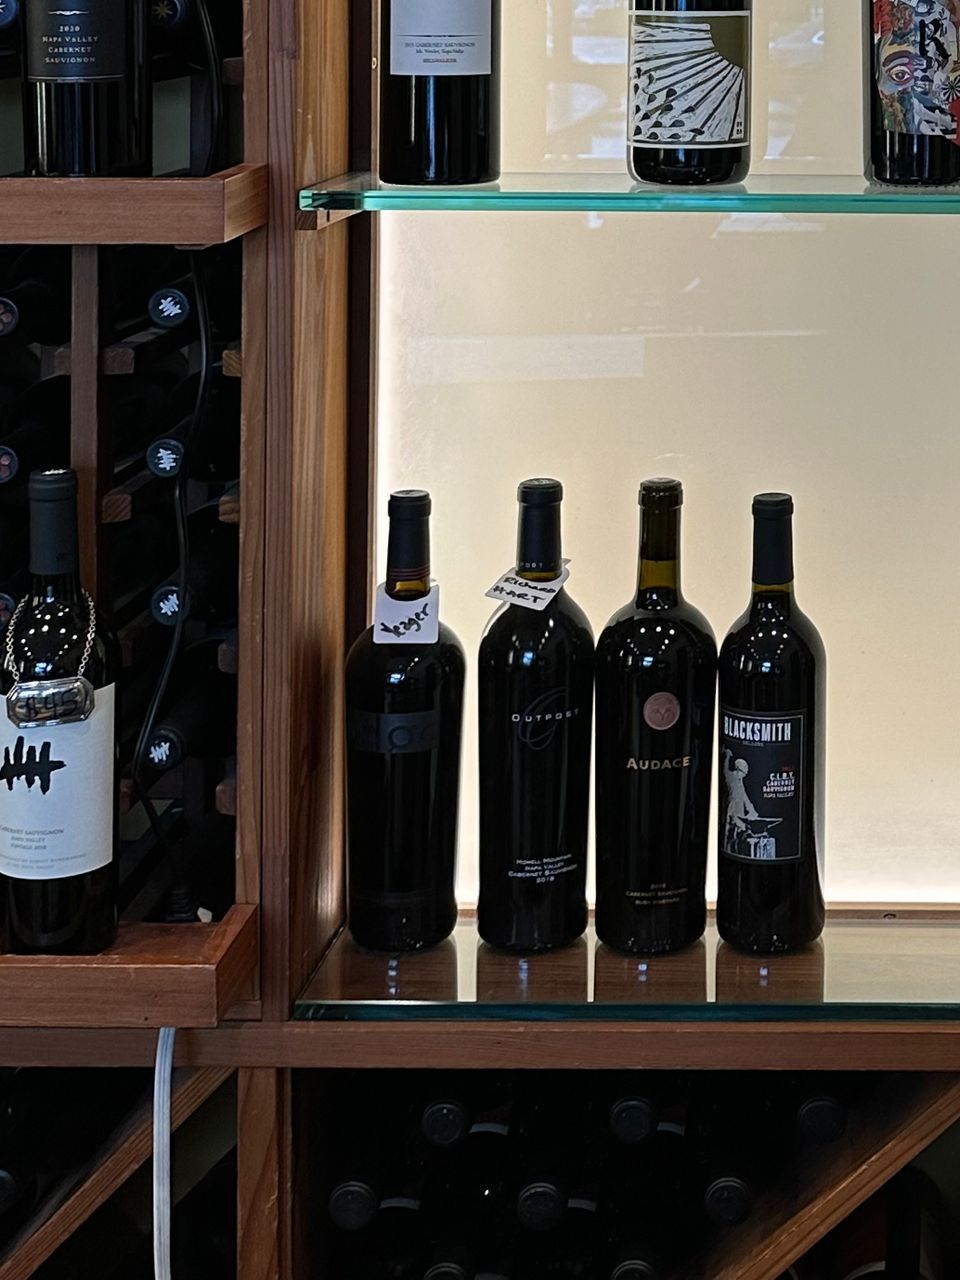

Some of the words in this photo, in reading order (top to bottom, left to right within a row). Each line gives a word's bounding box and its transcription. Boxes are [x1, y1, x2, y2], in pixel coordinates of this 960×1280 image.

[511, 708, 579, 723] OUTPOST
[724, 715, 792, 742] BLACKSMITH
[626, 756, 691, 770] AUDACE
